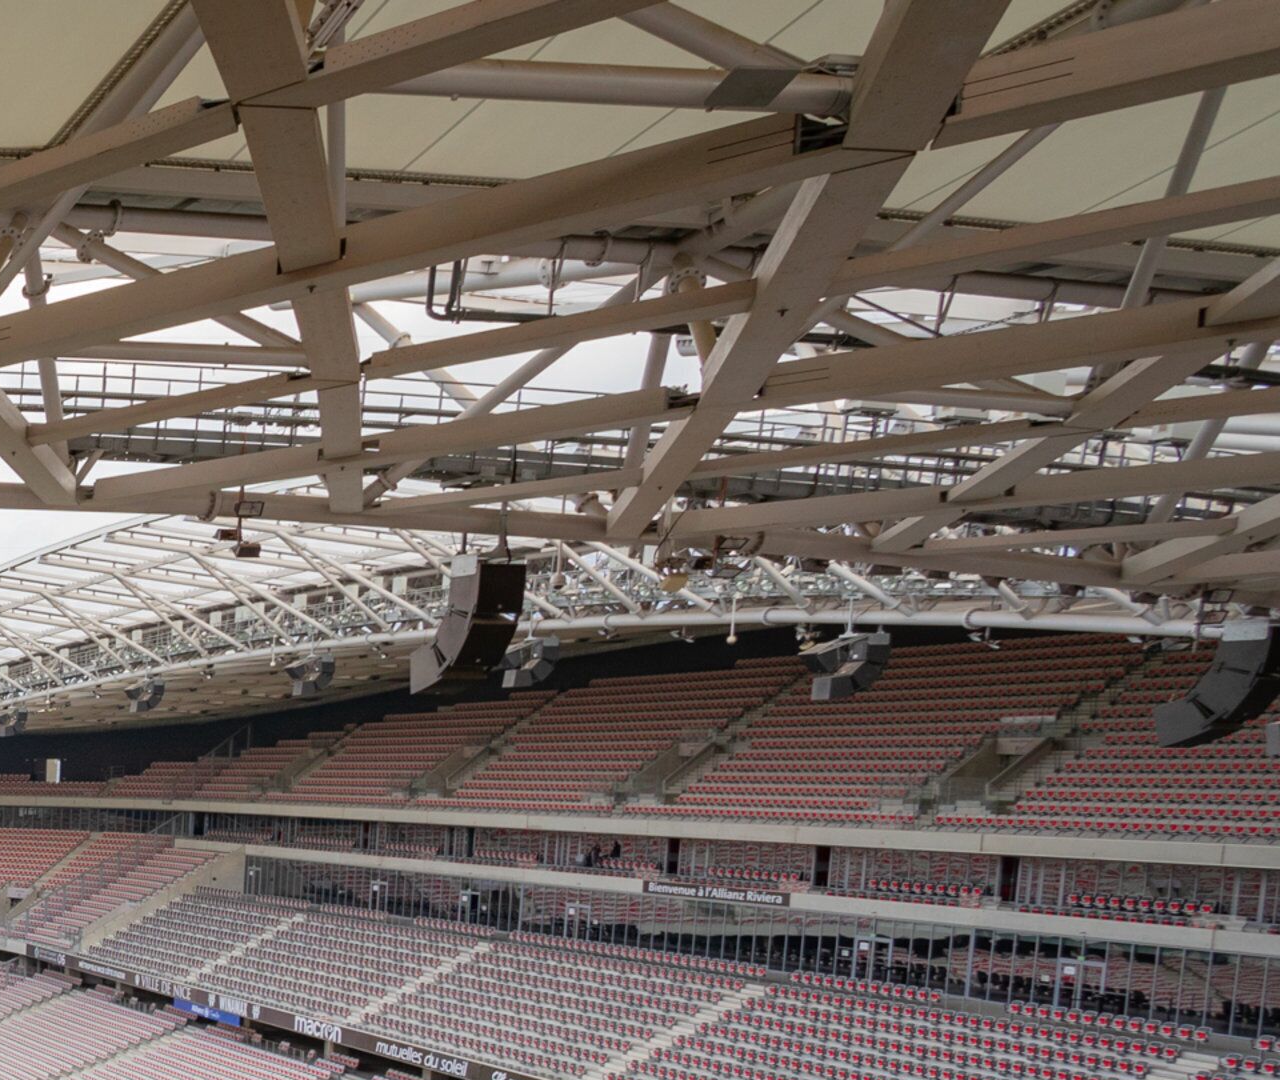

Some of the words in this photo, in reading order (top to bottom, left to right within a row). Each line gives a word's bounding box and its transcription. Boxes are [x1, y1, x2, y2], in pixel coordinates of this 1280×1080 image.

[648, 882, 697, 896] Bienvenue
[697, 886, 704, 897] à
[746, 891, 783, 904] Riviera
[294, 1015, 342, 1043] macron
[376, 1041, 423, 1065] mutuelles
[423, 1052, 439, 1069] du
[440, 1058, 469, 1076] soleil
